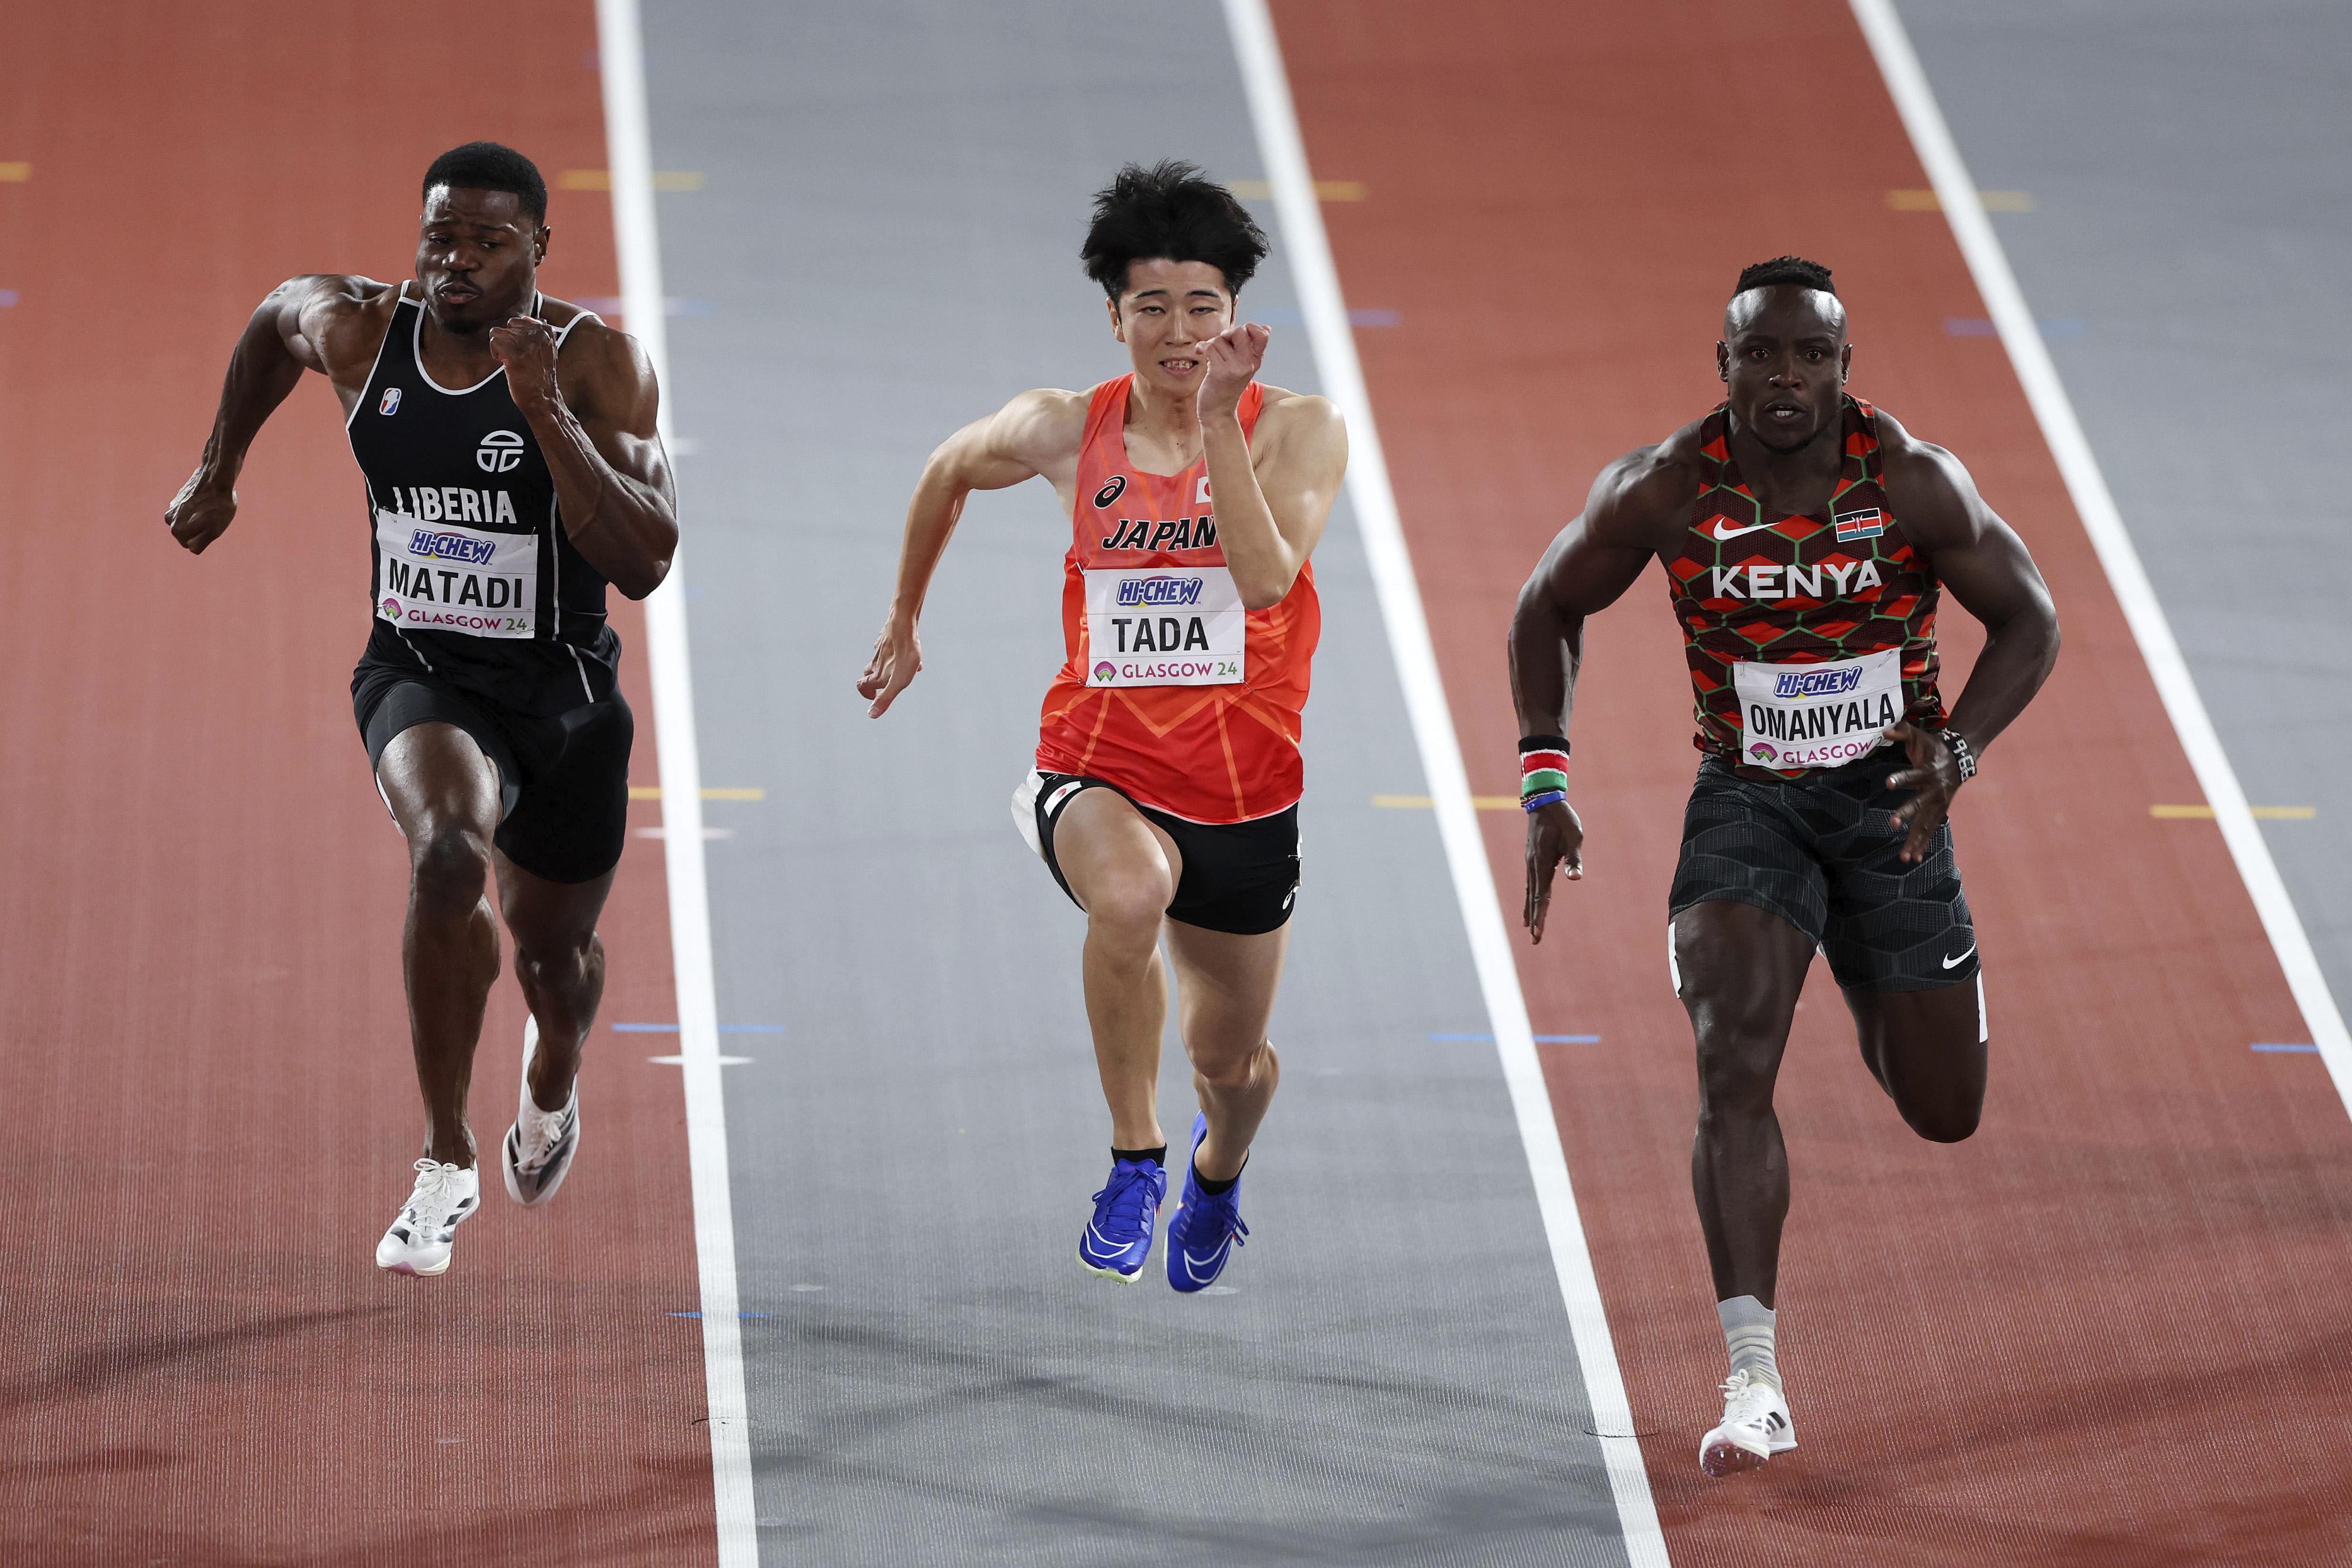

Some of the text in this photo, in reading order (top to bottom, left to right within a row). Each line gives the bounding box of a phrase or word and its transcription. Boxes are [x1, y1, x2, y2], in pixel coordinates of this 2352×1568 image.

[392, 487, 517, 524] LIBERIA
[408, 529, 496, 565] HI-CHEW
[1101, 514, 1217, 552] JAPAN
[389, 558, 522, 609] MATADI
[1116, 577, 1203, 606] HI-CHEW
[1712, 559, 1882, 599] KENYA
[407, 610, 527, 631] GLASGOW 24
[1112, 616, 1209, 653] TADA
[1122, 661, 1238, 679] GLASGOW 24
[1773, 665, 1863, 698] HI-CHEW
[1750, 693, 1896, 742] OMANYALA
[1782, 738, 1874, 764] GLASGOW
